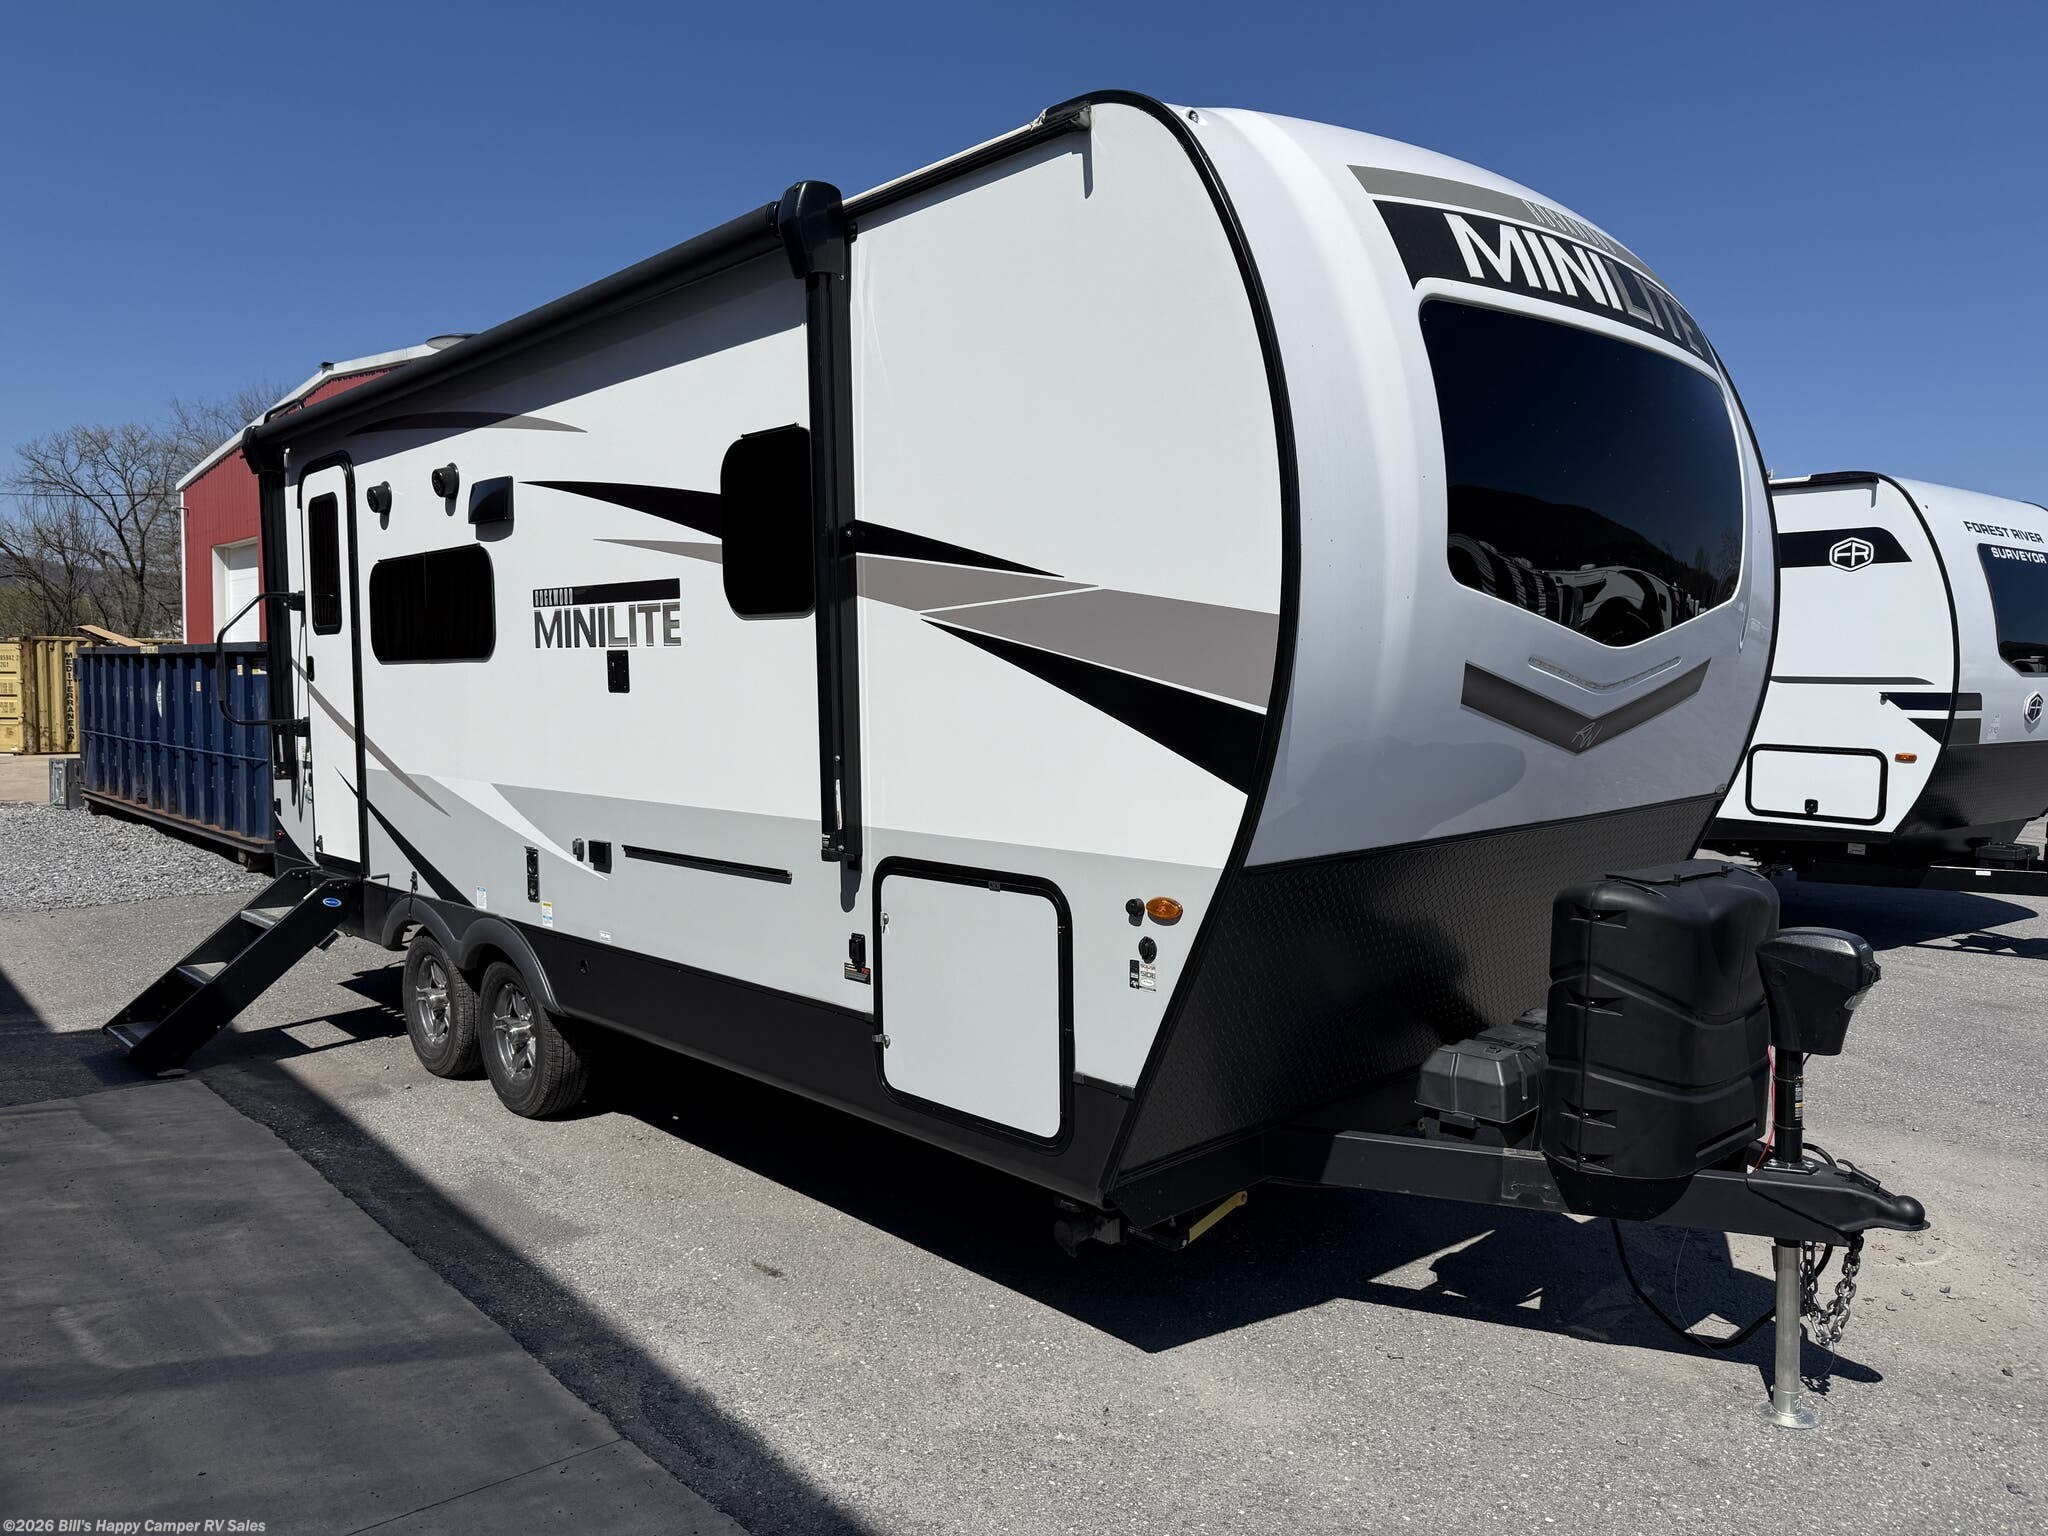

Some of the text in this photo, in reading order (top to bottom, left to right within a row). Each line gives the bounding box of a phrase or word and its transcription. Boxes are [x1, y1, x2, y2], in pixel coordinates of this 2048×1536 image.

[1443, 212, 1703, 356] MINILITE
[1963, 520, 2045, 544] FOREST RIVER
[1990, 546, 2047, 564] SURVEYOR
[534, 602, 682, 649] MINILITE
[64, 652, 75, 742] MEDITERRANEAN
